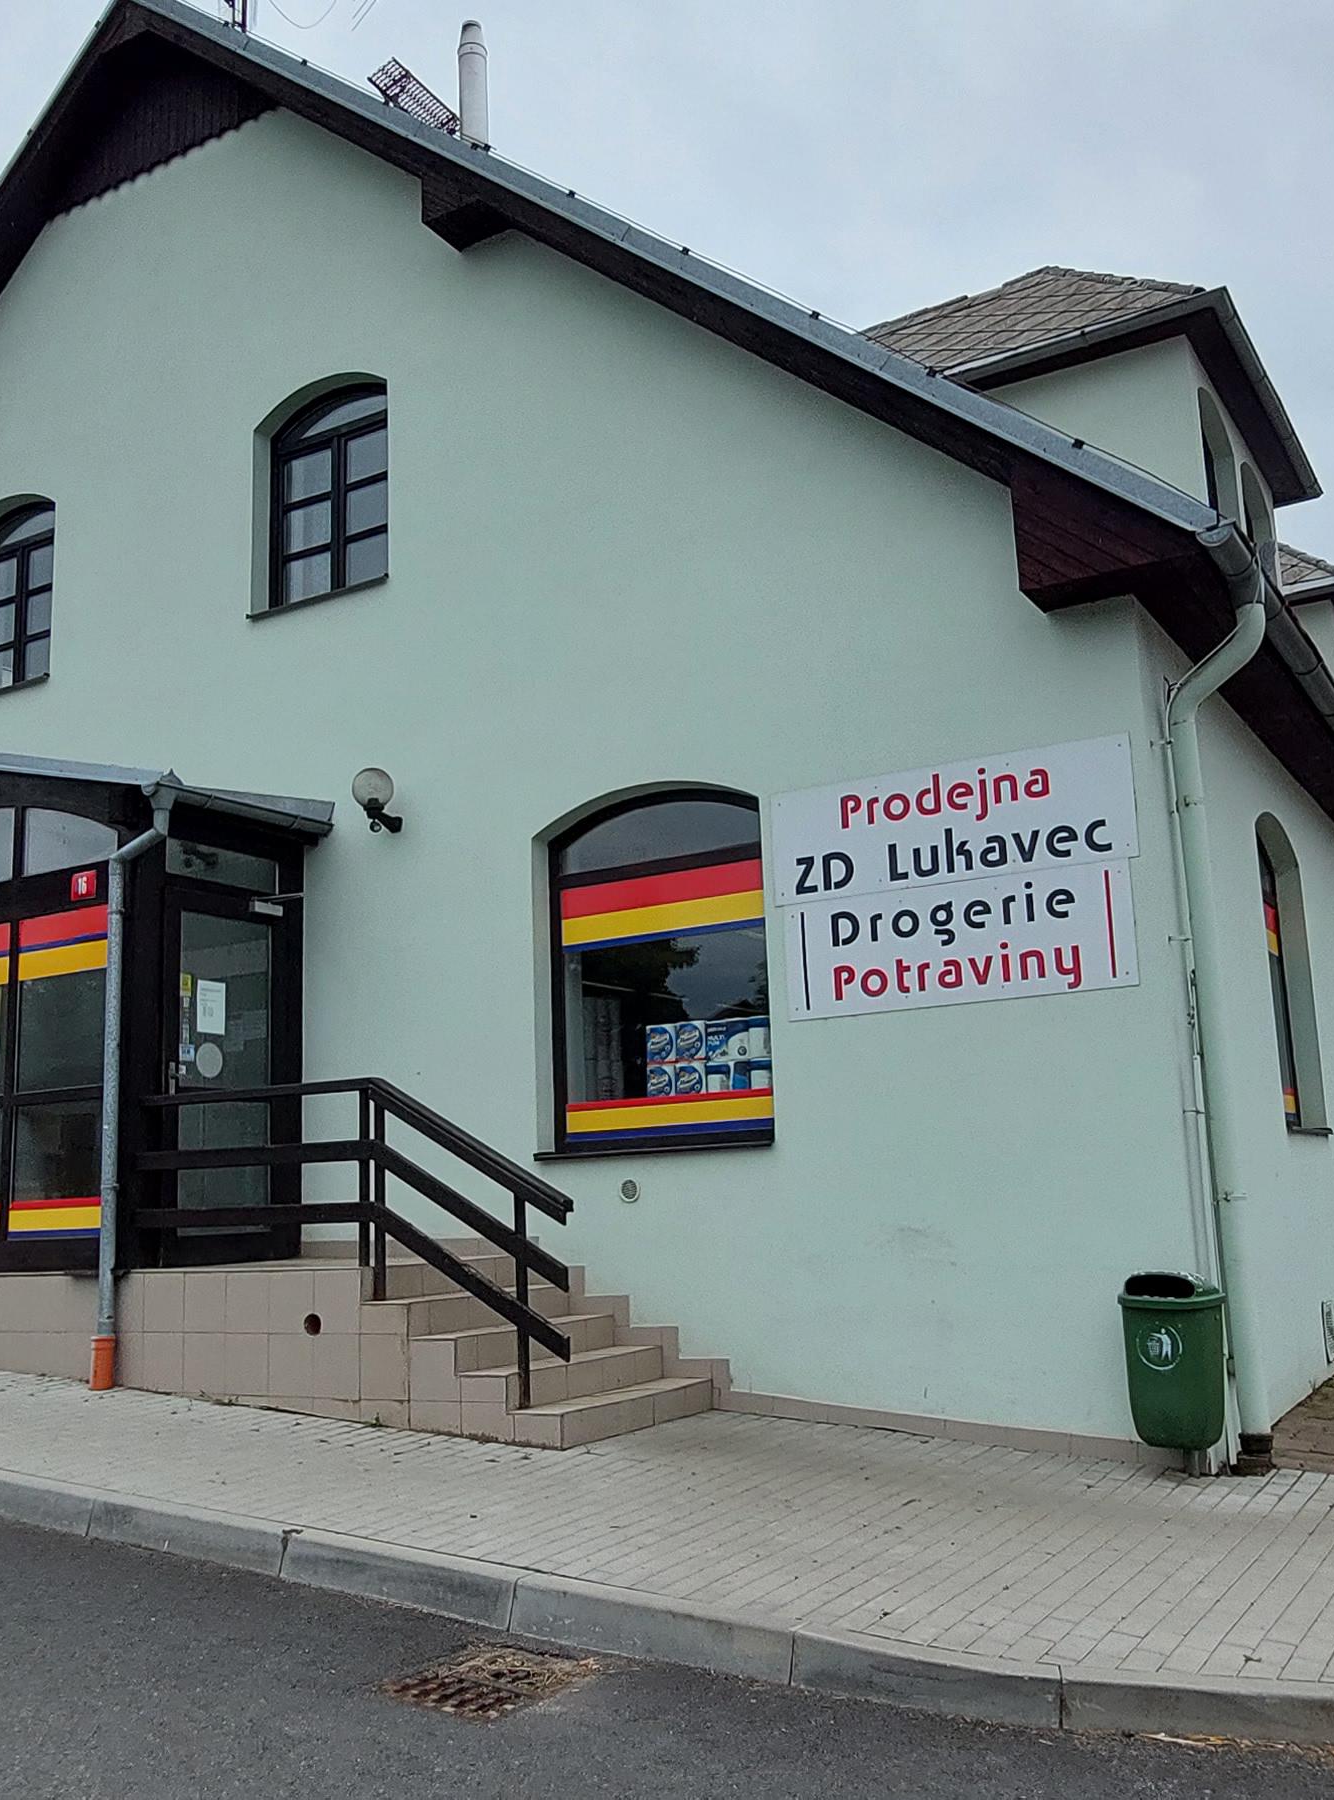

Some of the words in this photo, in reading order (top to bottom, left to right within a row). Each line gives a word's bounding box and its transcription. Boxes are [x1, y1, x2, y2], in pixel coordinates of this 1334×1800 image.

[839, 767, 1051, 829] Prodejna
[77, 876, 87, 896] 16
[794, 851, 855, 896] ZD
[887, 818, 1113, 882] Lukavec
[830, 881, 1076, 947] Drogerie
[833, 941, 1083, 1001] Potraviny
